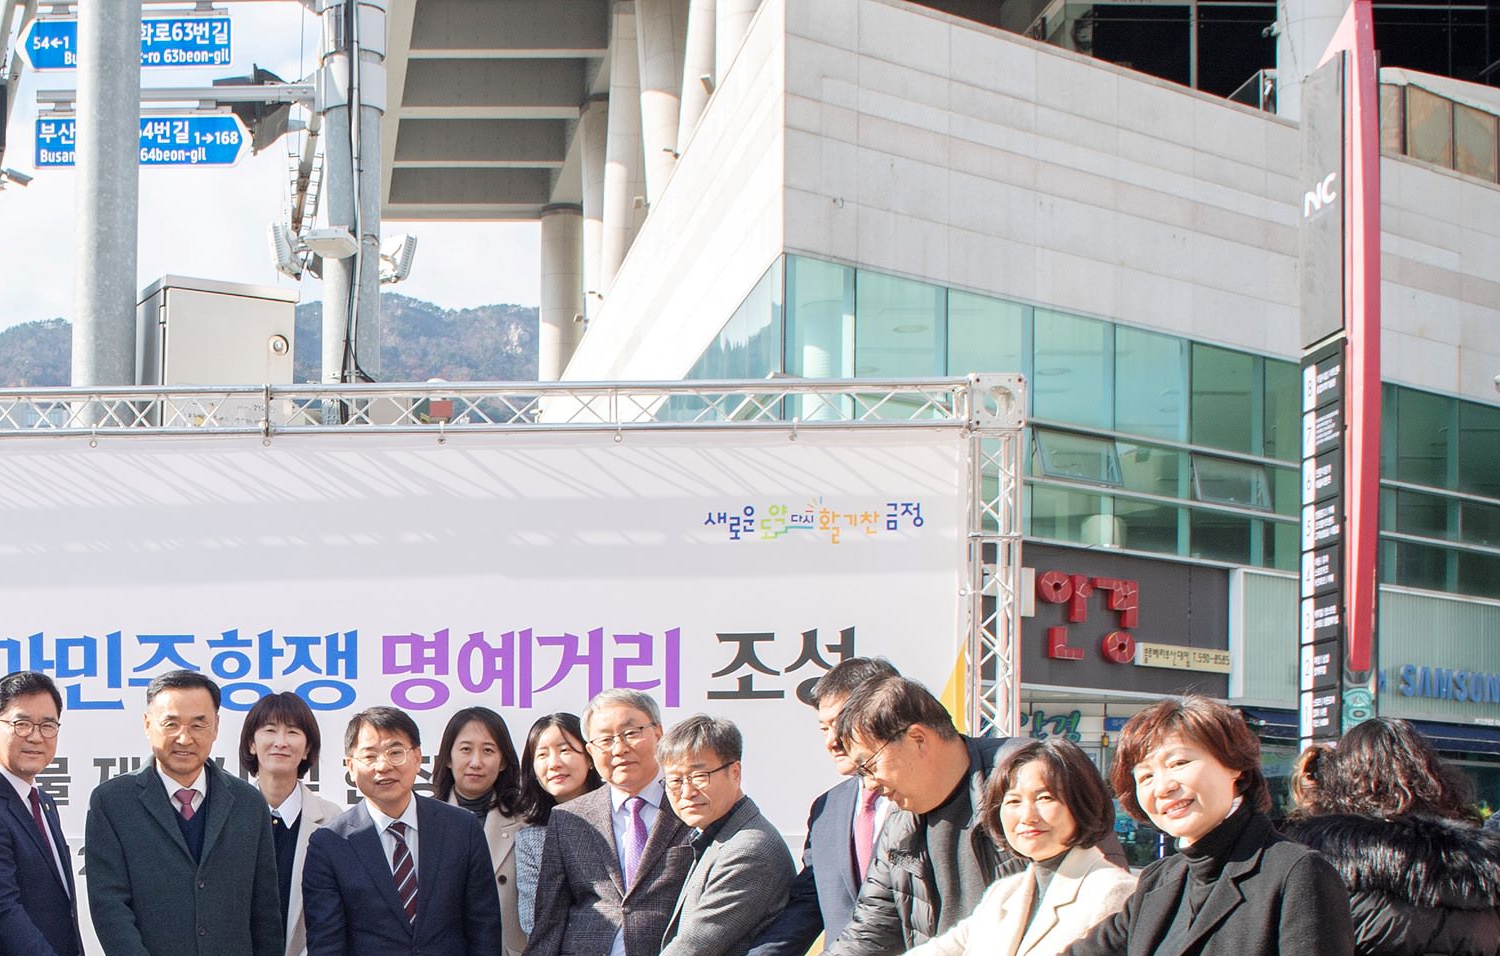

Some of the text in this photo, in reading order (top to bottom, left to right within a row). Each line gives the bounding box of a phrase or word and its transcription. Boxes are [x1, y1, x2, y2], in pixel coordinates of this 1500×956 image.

[33, 36, 50, 50] 54
[141, 22, 229, 45] 학로63번길
[163, 49, 230, 64] 63beon-gil
[39, 122, 76, 145] 부산
[140, 121, 189, 144] 4번길
[214, 131, 239, 144] 168
[140, 147, 207, 164] 64beon-gil
[1304, 172, 1337, 218] NC
[704, 505, 754, 540] 새로운
[819, 508, 880, 544] 활기찬
[886, 503, 924, 530] 금정
[1037, 570, 1139, 663] 안경
[382, 627, 681, 719] 명예거리
